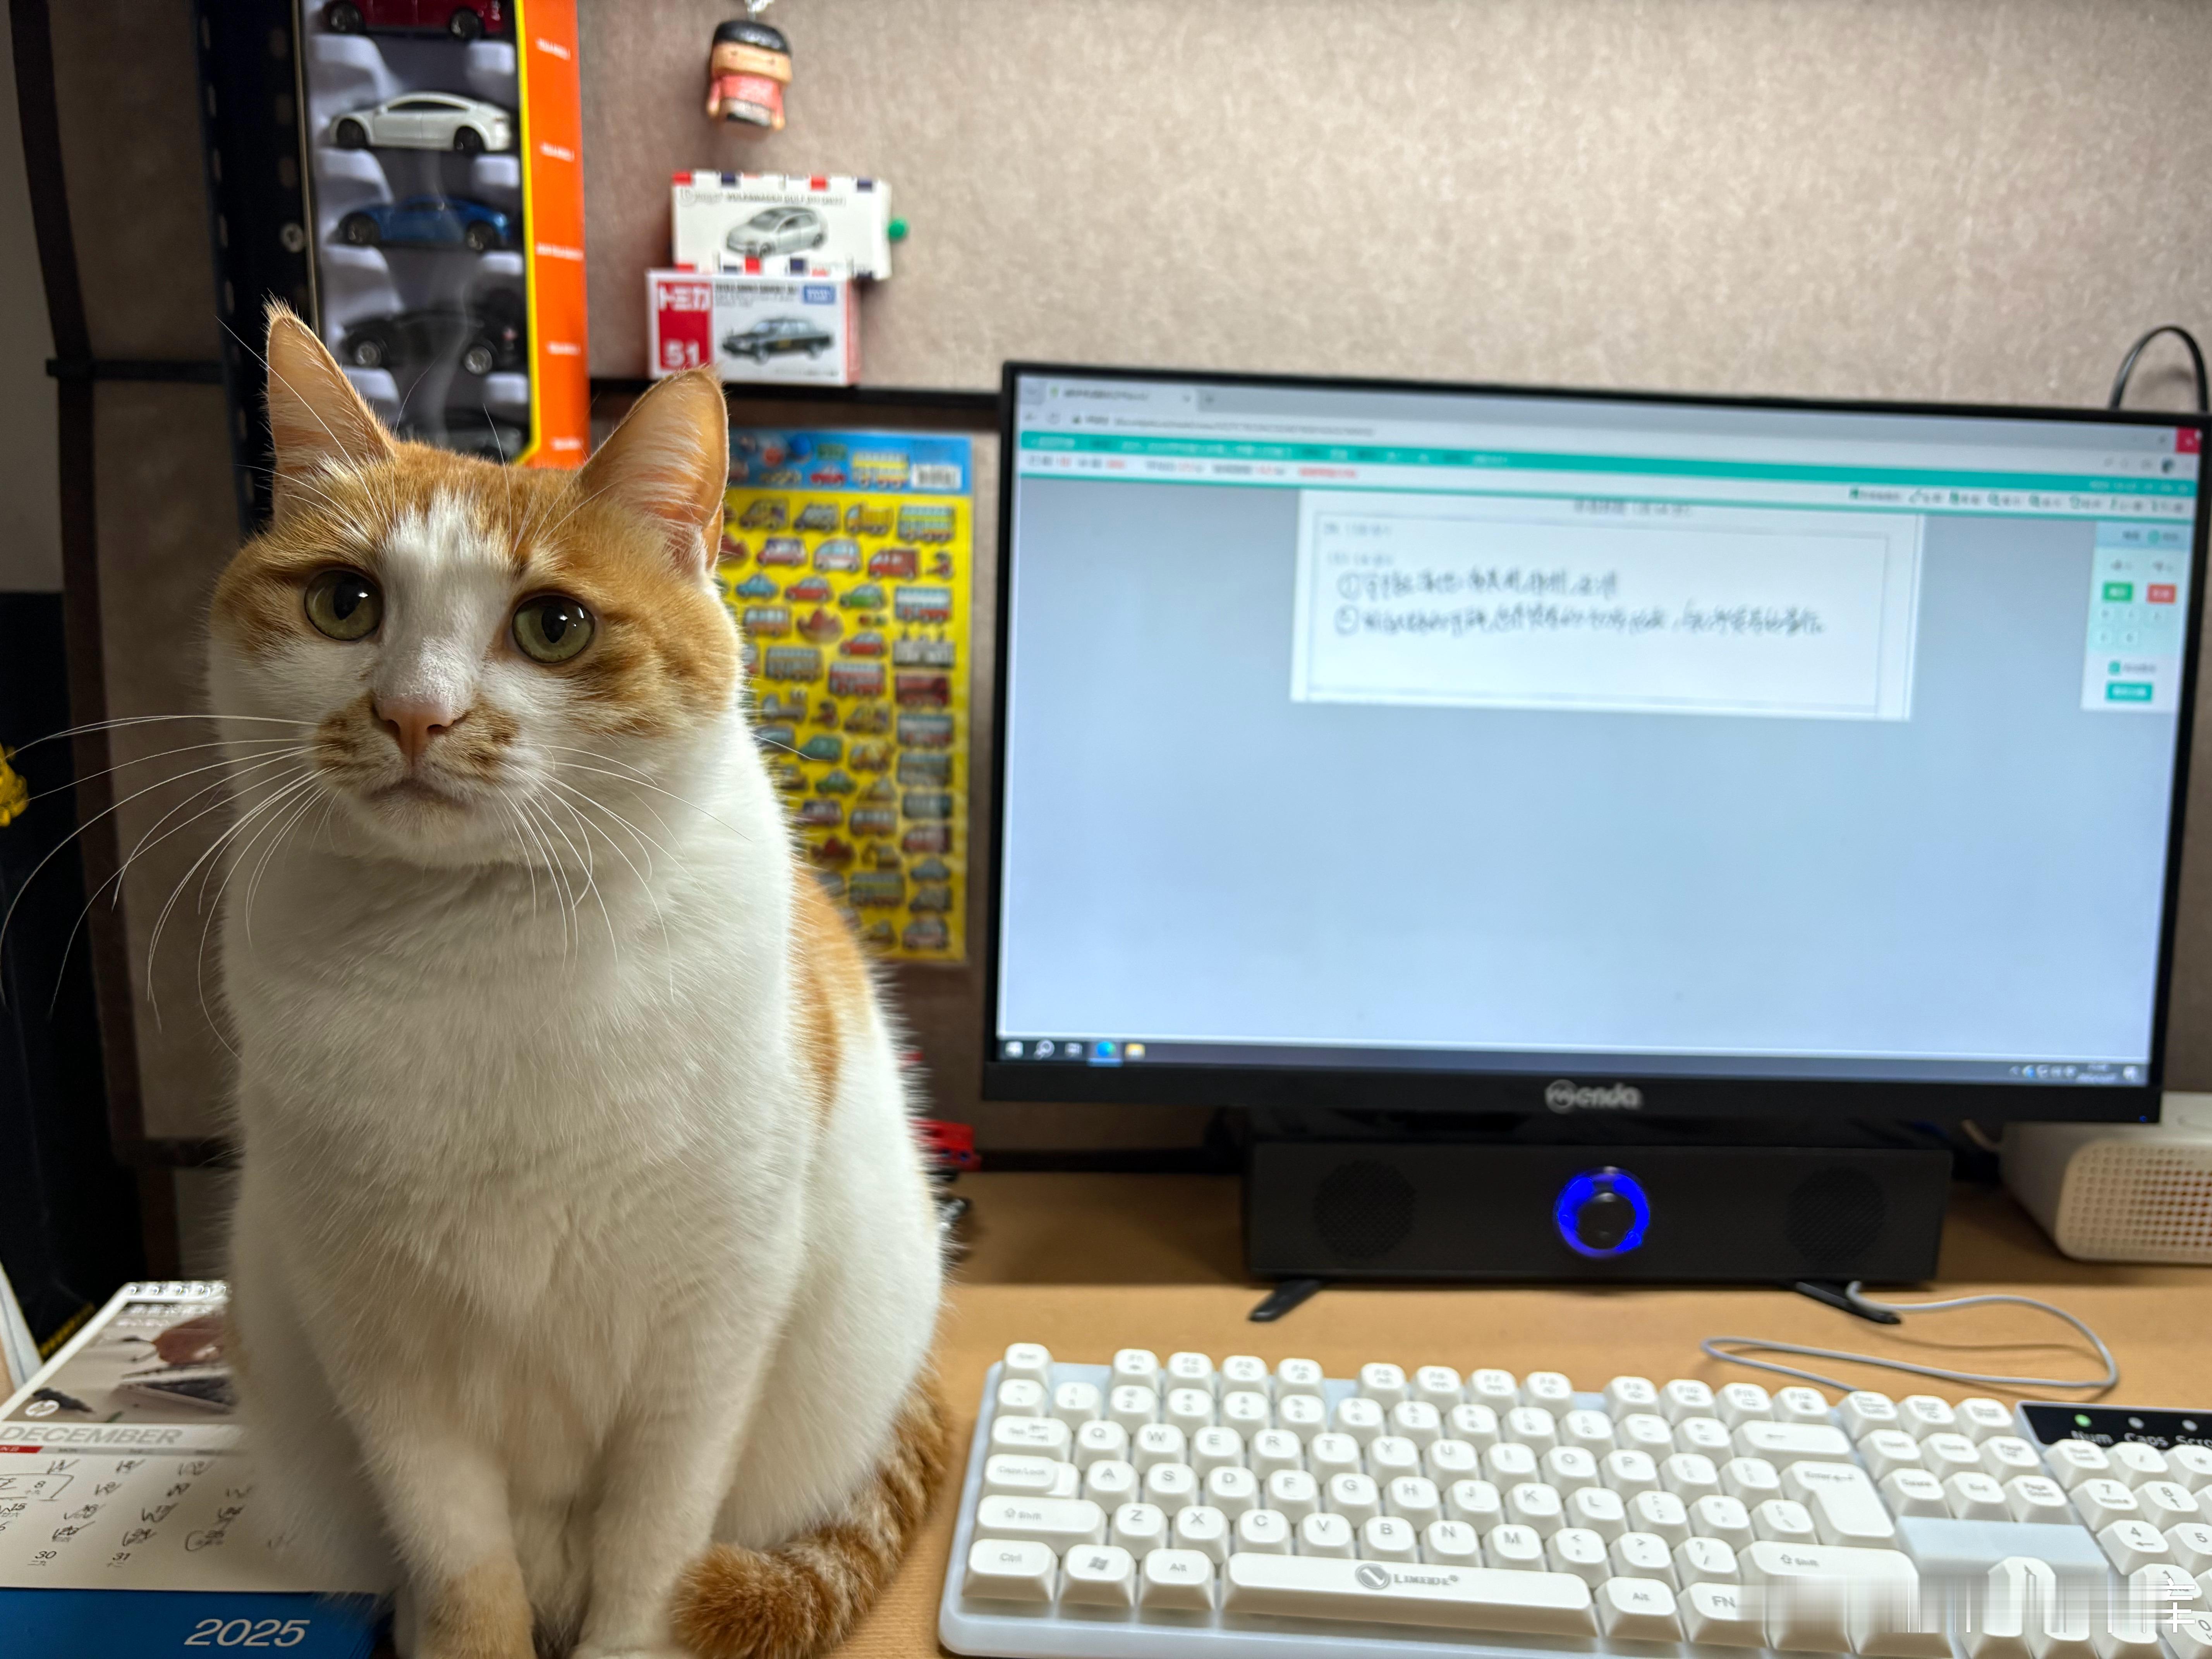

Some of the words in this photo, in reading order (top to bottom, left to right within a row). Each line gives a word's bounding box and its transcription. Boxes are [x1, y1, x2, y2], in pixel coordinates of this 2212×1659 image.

[658, 285, 711, 311] トミカ
[664, 340, 700, 367] 51
[0, 1426, 183, 1444] DECEMBER
[1091, 1427, 1106, 1438] Q
[1147, 1431, 1166, 1442] W
[1207, 1434, 1220, 1445] E
[1266, 1436, 1279, 1446] R
[1323, 1439, 1335, 1451] T
[2124, 1432, 2168, 1447] Caps
[1381, 1441, 1392, 1453] Y
[1440, 1444, 1455, 1455] U
[1561, 1453, 1577, 1464] O
[1621, 1456, 1635, 1468] P
[1100, 1467, 1116, 1480] A
[1162, 1470, 1176, 1481] S
[1221, 1472, 1237, 1483] D
[1283, 1477, 1296, 1489] F
[1342, 1479, 1358, 1491] G
[1403, 1483, 1418, 1495] H
[2101, 1484, 2111, 1494] 7
[1465, 1486, 1475, 1496] J
[1523, 1490, 1539, 1502] K
[2161, 1487, 2174, 1497] 8
[10, 1503, 27, 1511] 15
[1587, 1495, 1602, 1507] L
[1130, 1509, 1144, 1521] Z
[1191, 1512, 1205, 1525] X
[1253, 1515, 1268, 1527] C
[1317, 1519, 1331, 1531] V
[1380, 1523, 1393, 1535] B
[1441, 1525, 1456, 1537] N
[1503, 1532, 1522, 1544] M
[2130, 1527, 2142, 1537] 4
[2194, 1532, 2208, 1543] 5
[34, 1551, 57, 1559] 30
[112, 1552, 131, 1561] 31
[1169, 1562, 1187, 1571] Alt
[1632, 1592, 1650, 1601] Alt
[1712, 1595, 1736, 1608] FN
[2198, 1620, 2212, 1631] 0
[184, 1618, 310, 1647] 2025
